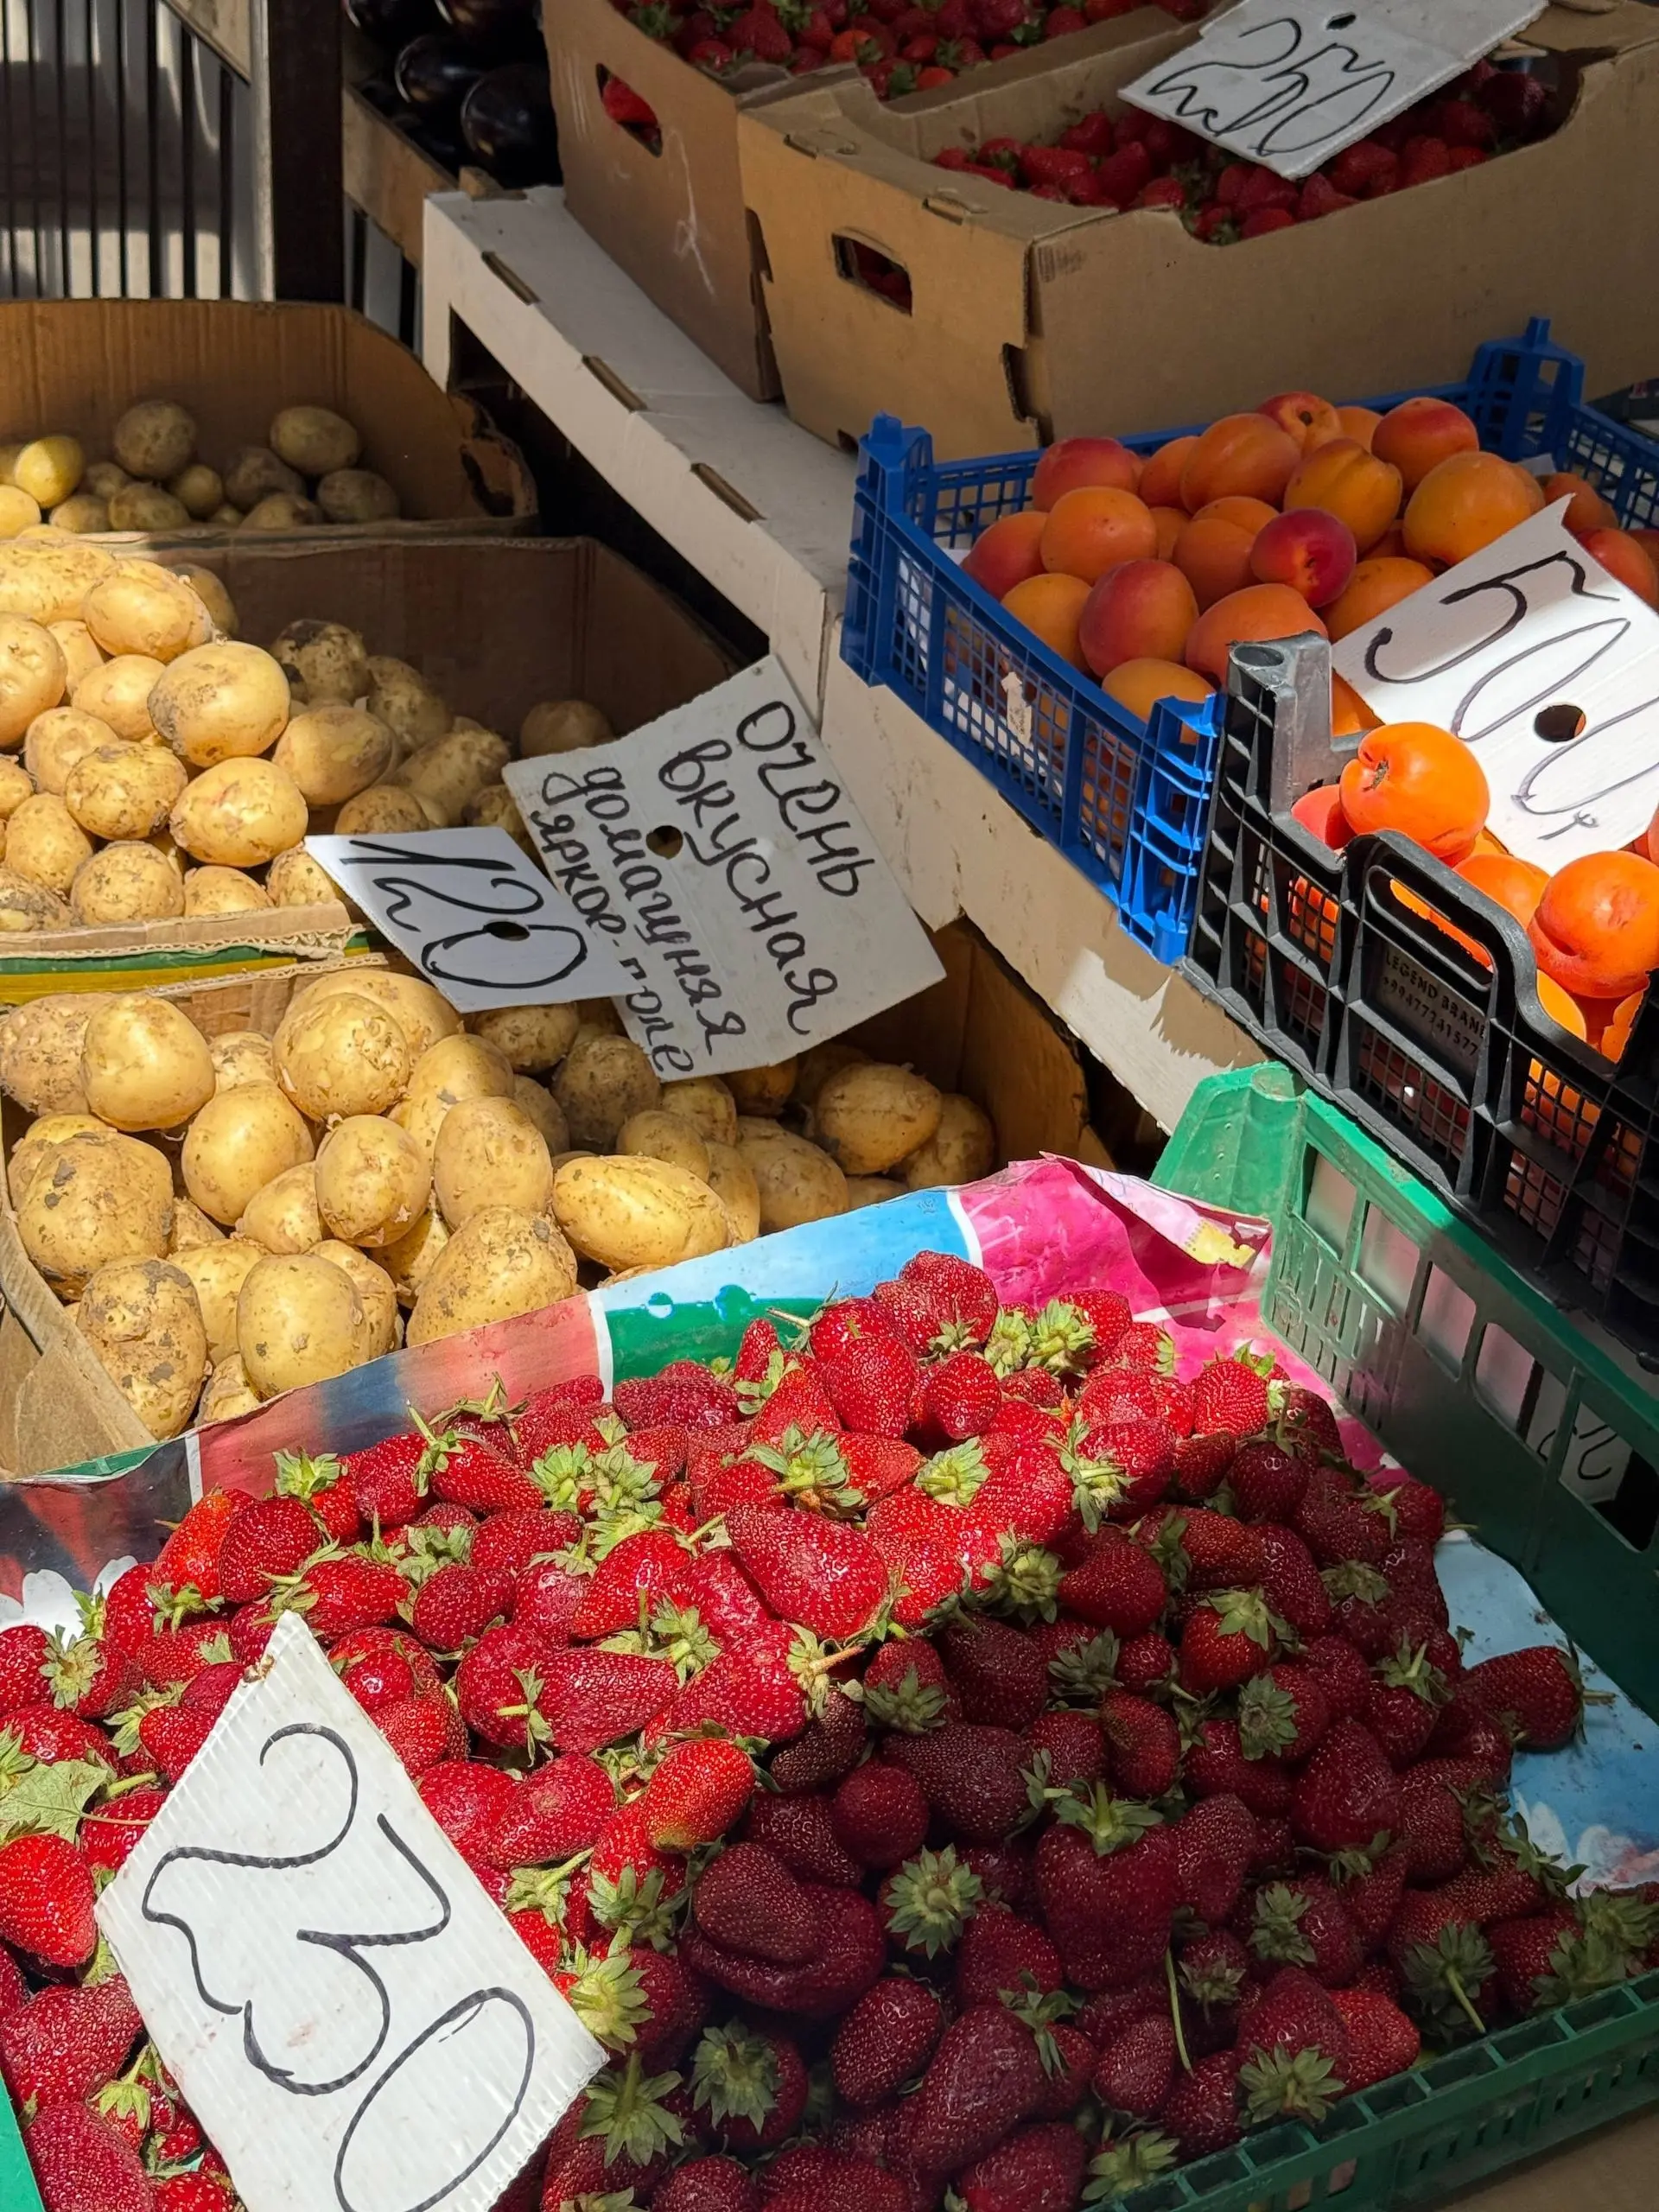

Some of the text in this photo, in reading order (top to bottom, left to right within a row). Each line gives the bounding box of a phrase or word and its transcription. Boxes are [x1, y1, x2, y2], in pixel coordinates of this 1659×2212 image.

[1147, 17, 1395, 156] 250
[1363, 550, 1659, 816] 500
[340, 840, 588, 989] 120
[1386, 952, 1439, 999] LEGEND
[142, 1723, 535, 2212] 230
